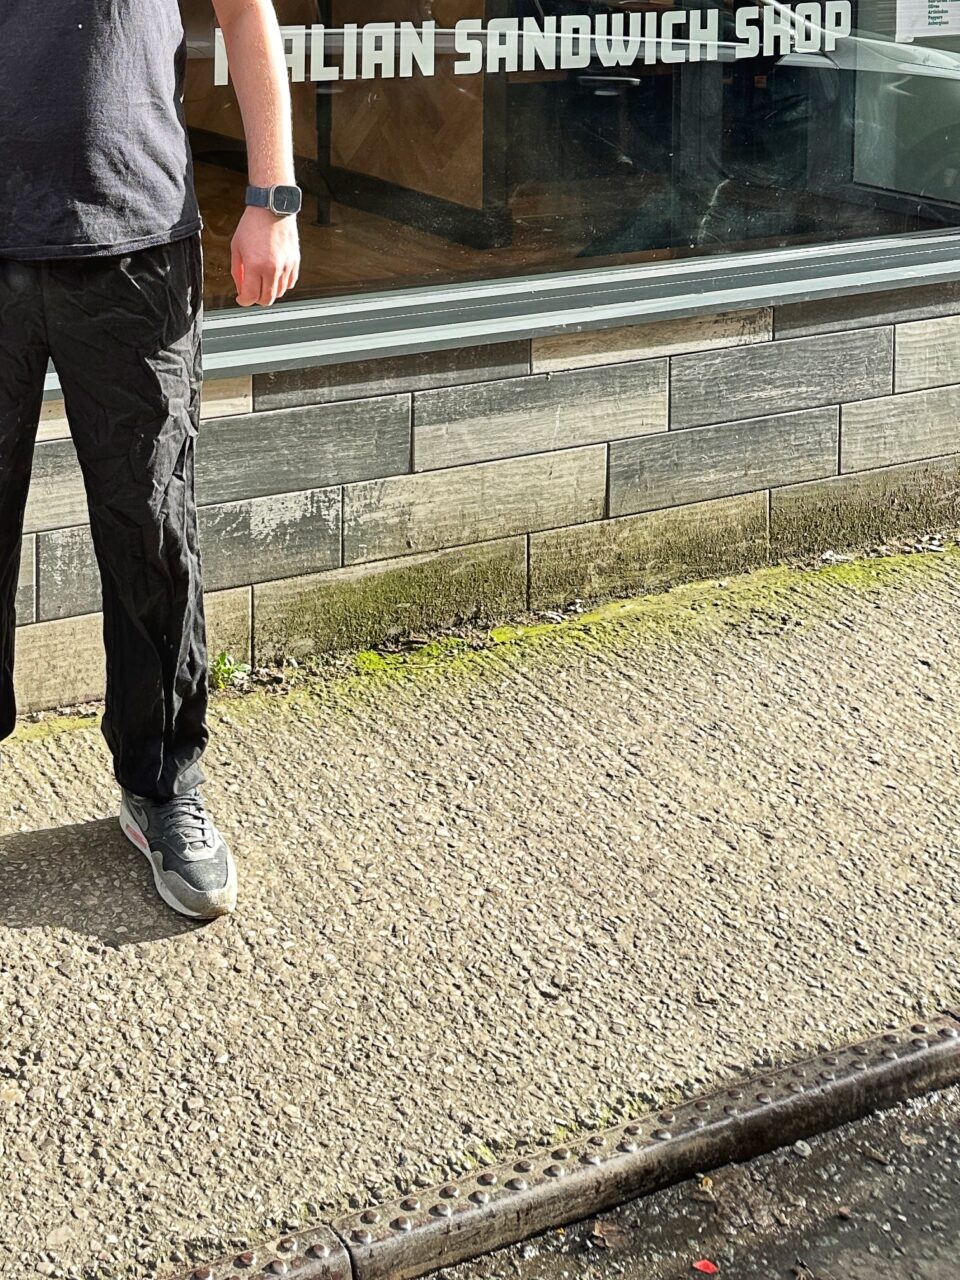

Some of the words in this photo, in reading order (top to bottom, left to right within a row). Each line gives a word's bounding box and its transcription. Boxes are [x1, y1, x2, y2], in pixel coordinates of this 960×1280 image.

[214, 20, 435, 86] IALIAN
[454, 8, 719, 75] SANDWICH
[735, 0, 852, 59] SHOP
